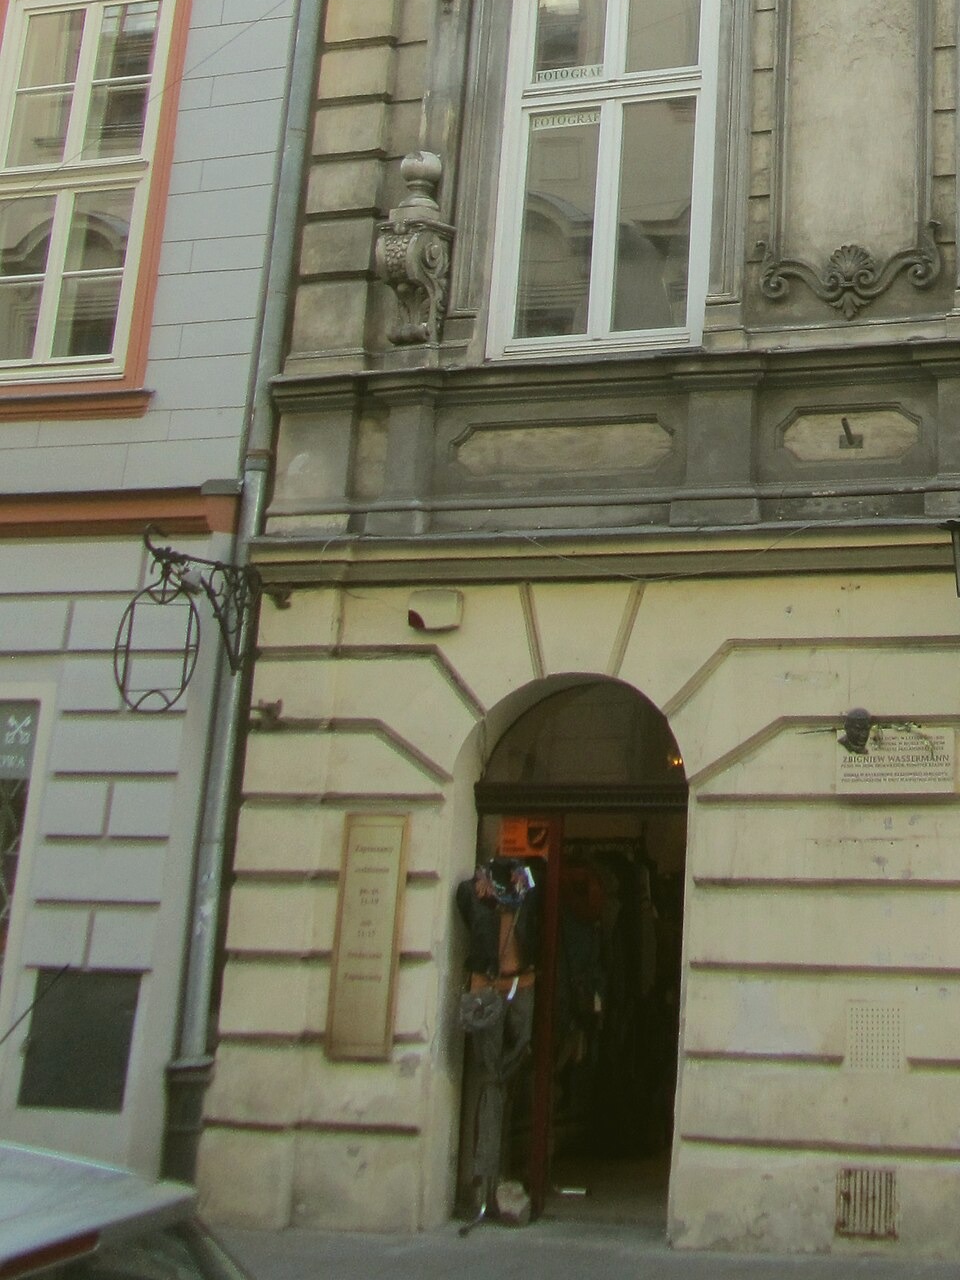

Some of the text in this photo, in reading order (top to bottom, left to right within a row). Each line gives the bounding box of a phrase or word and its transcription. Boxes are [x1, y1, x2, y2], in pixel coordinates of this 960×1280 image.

[537, 65, 603, 82] FOTOGRAF
[533, 113, 600, 128] FOTOGRAF
[843, 754, 950, 763] ZBIGNIEW WASSERMANN
